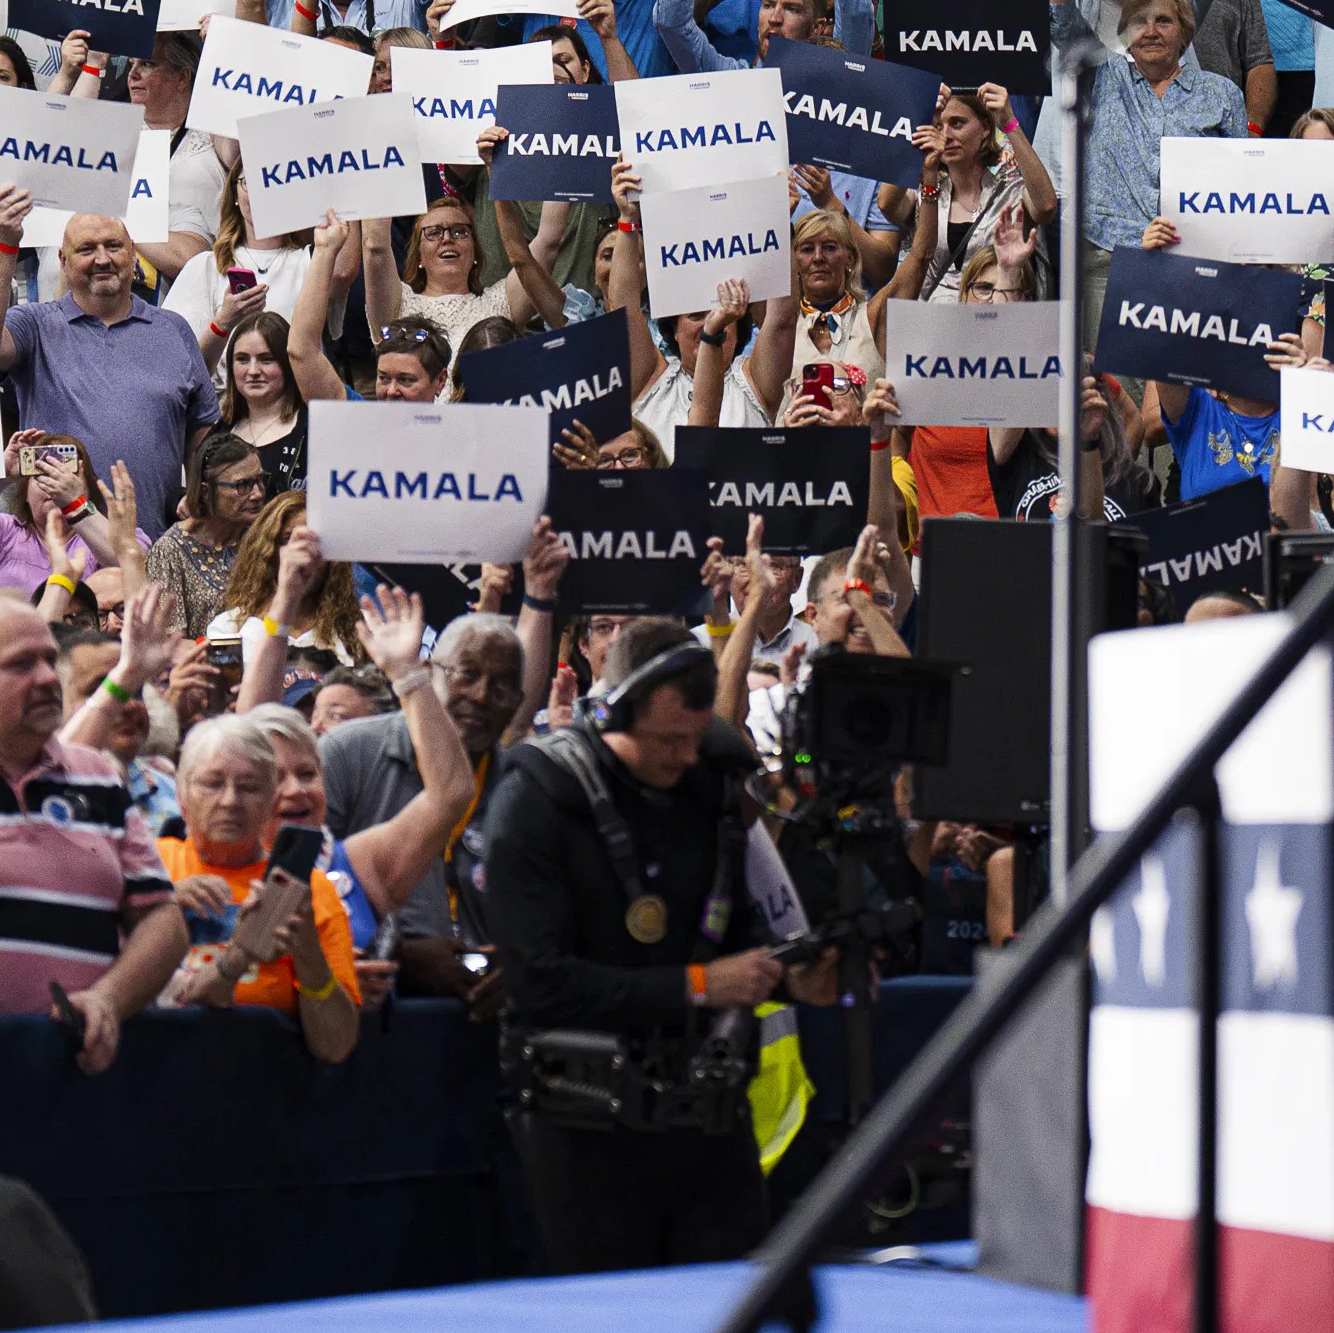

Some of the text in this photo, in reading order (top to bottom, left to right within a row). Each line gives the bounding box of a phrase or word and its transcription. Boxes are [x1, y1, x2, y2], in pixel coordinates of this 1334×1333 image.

[899, 31, 1037, 53] KAMALA
[412, 97, 497, 119] KAMA
[508, 133, 619, 157] KAMAL
[635, 121, 776, 153] KAMALA
[261, 145, 405, 189] KAMALA
[1178, 191, 1331, 215] KAMALA
[660, 228, 780, 269] KAMALA
[1118, 300, 1275, 348] KAMALA
[905, 354, 1060, 379] KAMALA
[329, 470, 522, 502] KAMALA
[559, 532, 696, 560] AMALA
[1142, 531, 1265, 584] KAMAL
